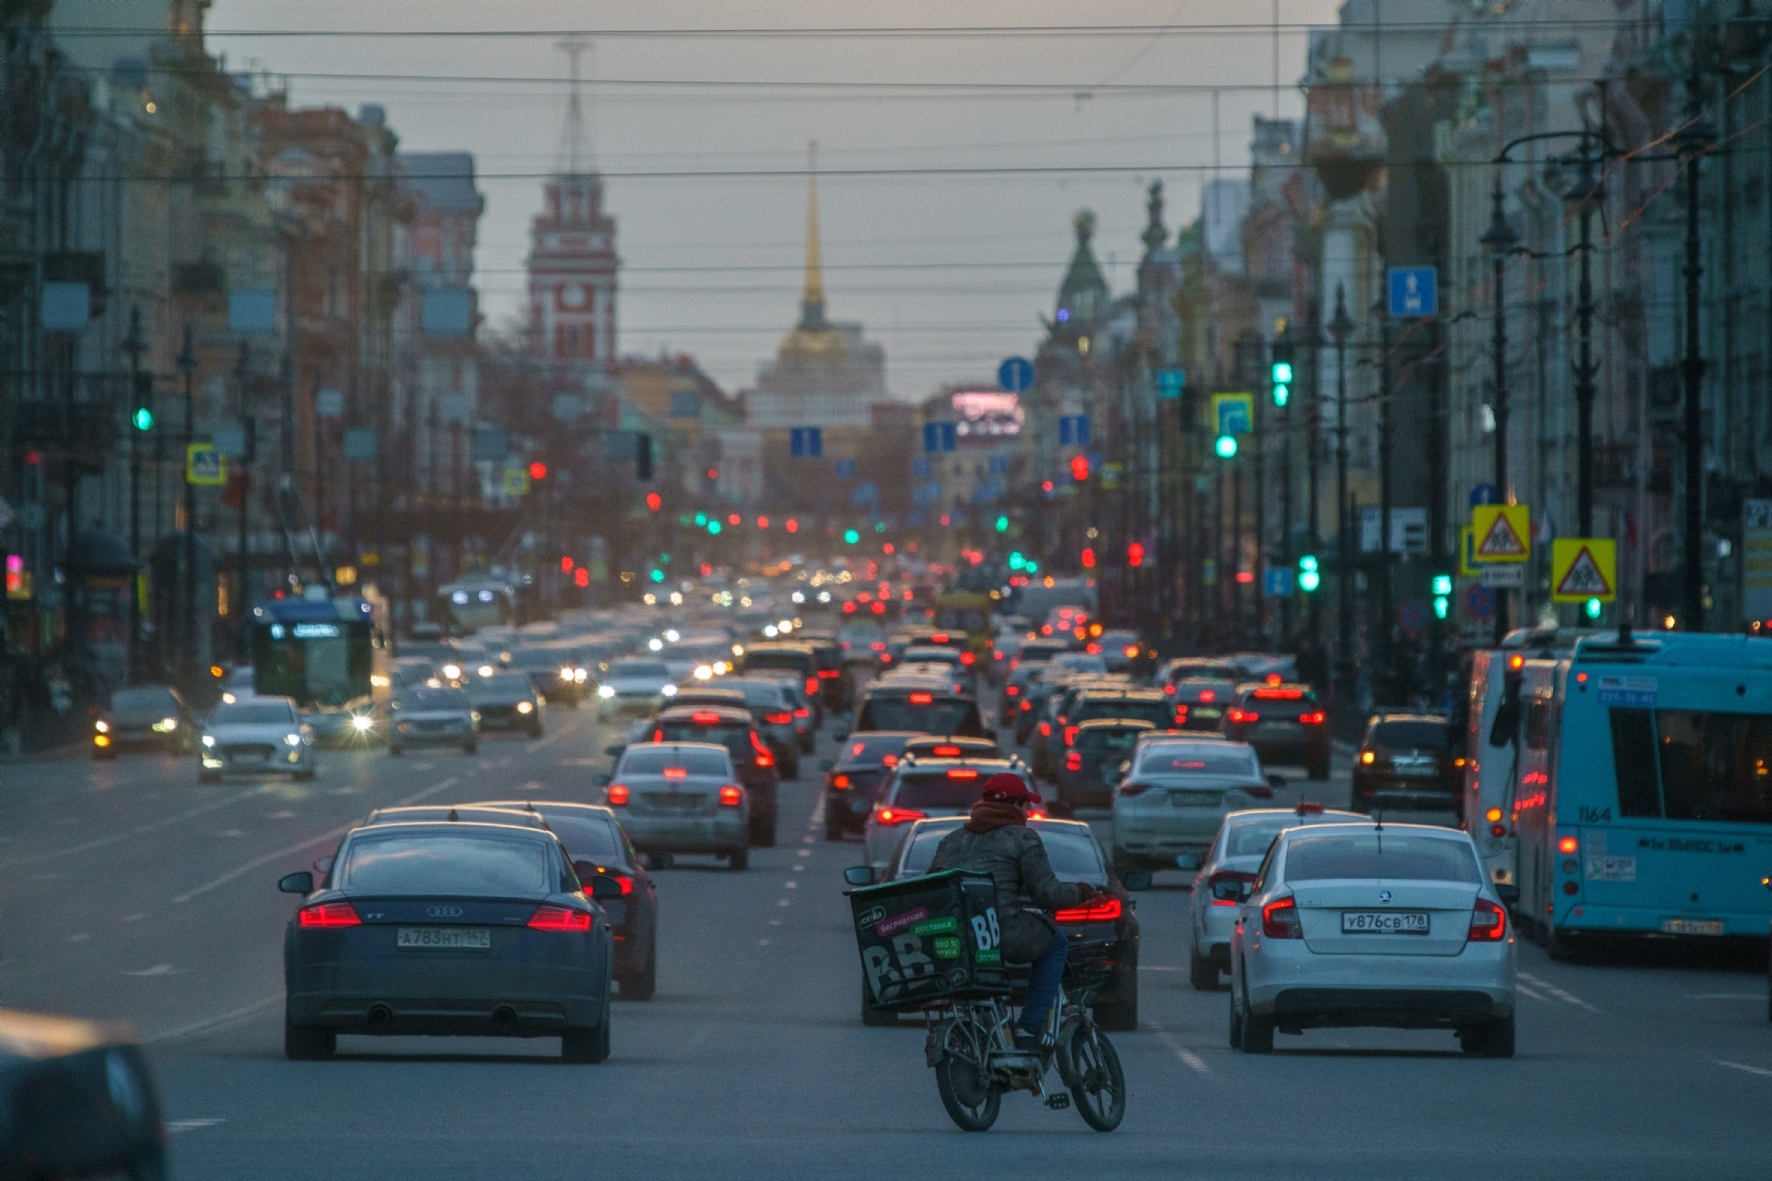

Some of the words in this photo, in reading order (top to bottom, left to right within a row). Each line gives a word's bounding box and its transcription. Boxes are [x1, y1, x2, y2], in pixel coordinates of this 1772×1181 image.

[1579, 807, 1611, 824] 1164
[880, 911, 925, 933] бесплатная
[914, 921, 952, 934] доставка
[1348, 915, 1401, 928] У876СВ
[1404, 914, 1425, 925] 178
[935, 940, 949, 949] 100
